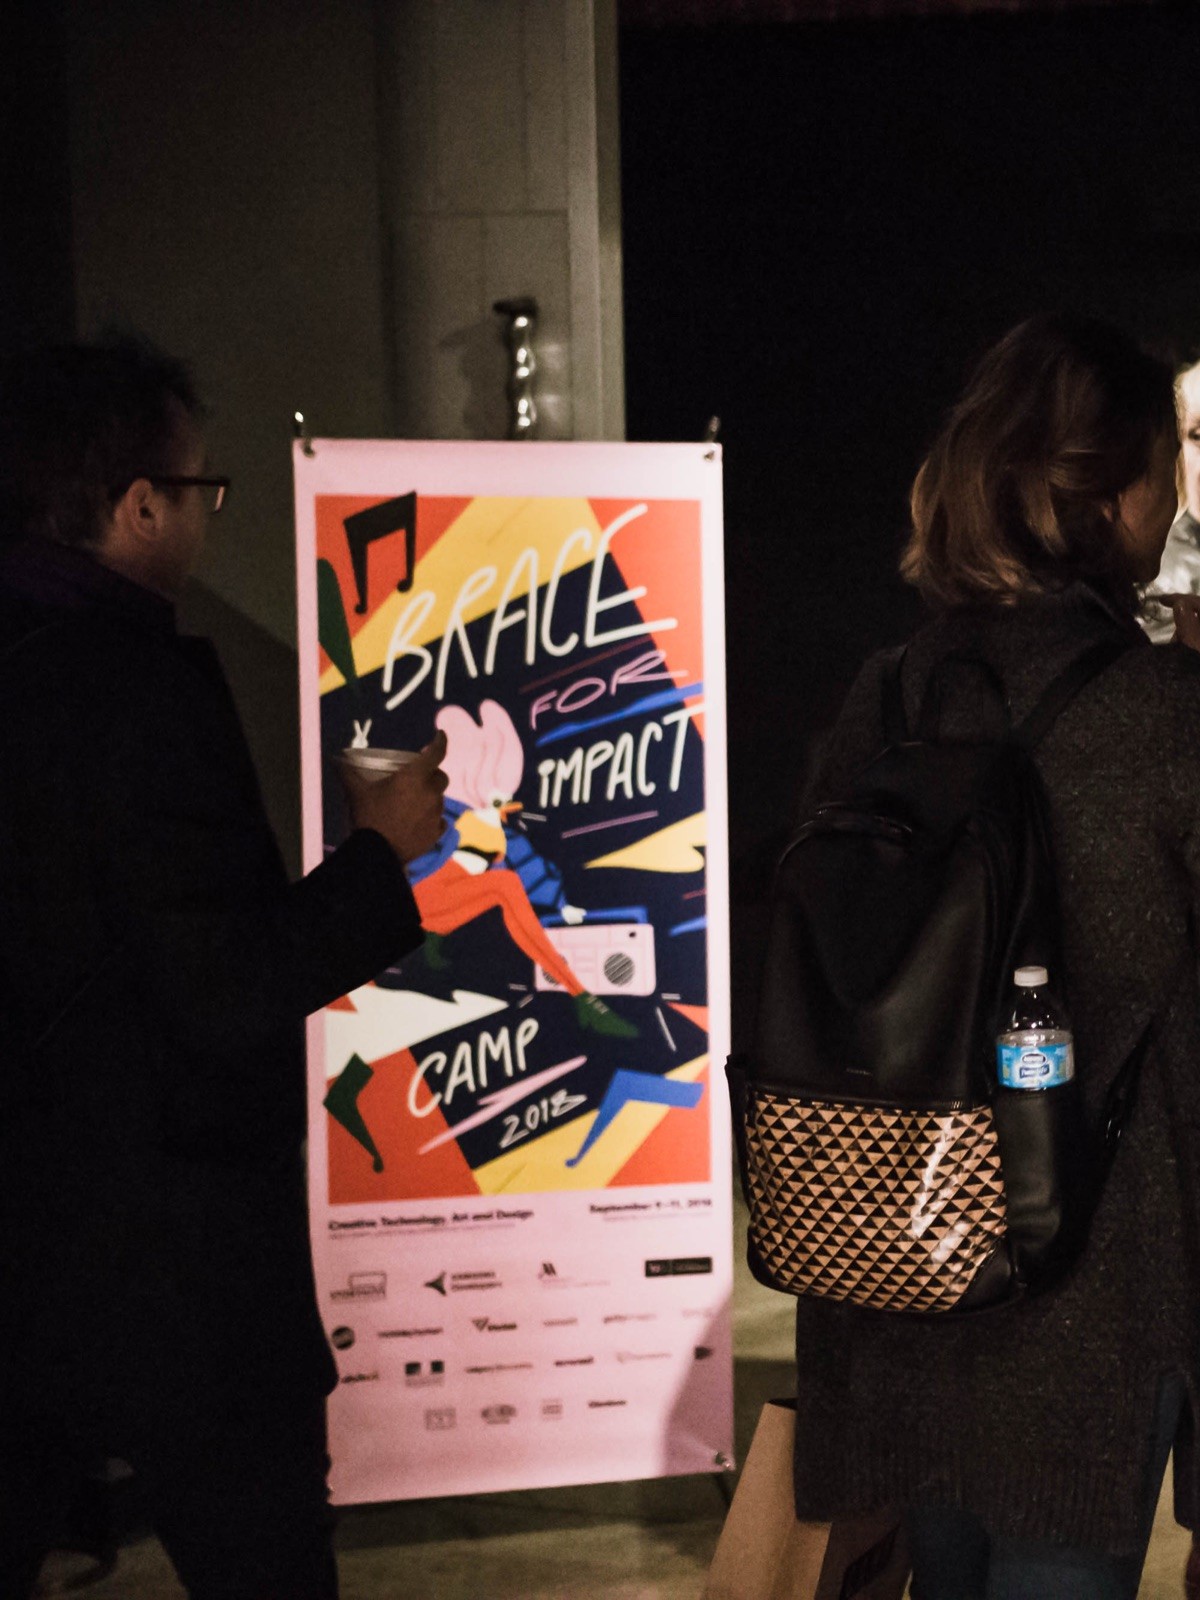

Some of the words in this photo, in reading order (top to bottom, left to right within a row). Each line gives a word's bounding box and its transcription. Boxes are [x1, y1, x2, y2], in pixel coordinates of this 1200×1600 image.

[381, 503, 678, 710] BRACE
[529, 650, 689, 730] FOR
[407, 1017, 540, 1119] CAMP
[498, 1088, 588, 1149] 2018
